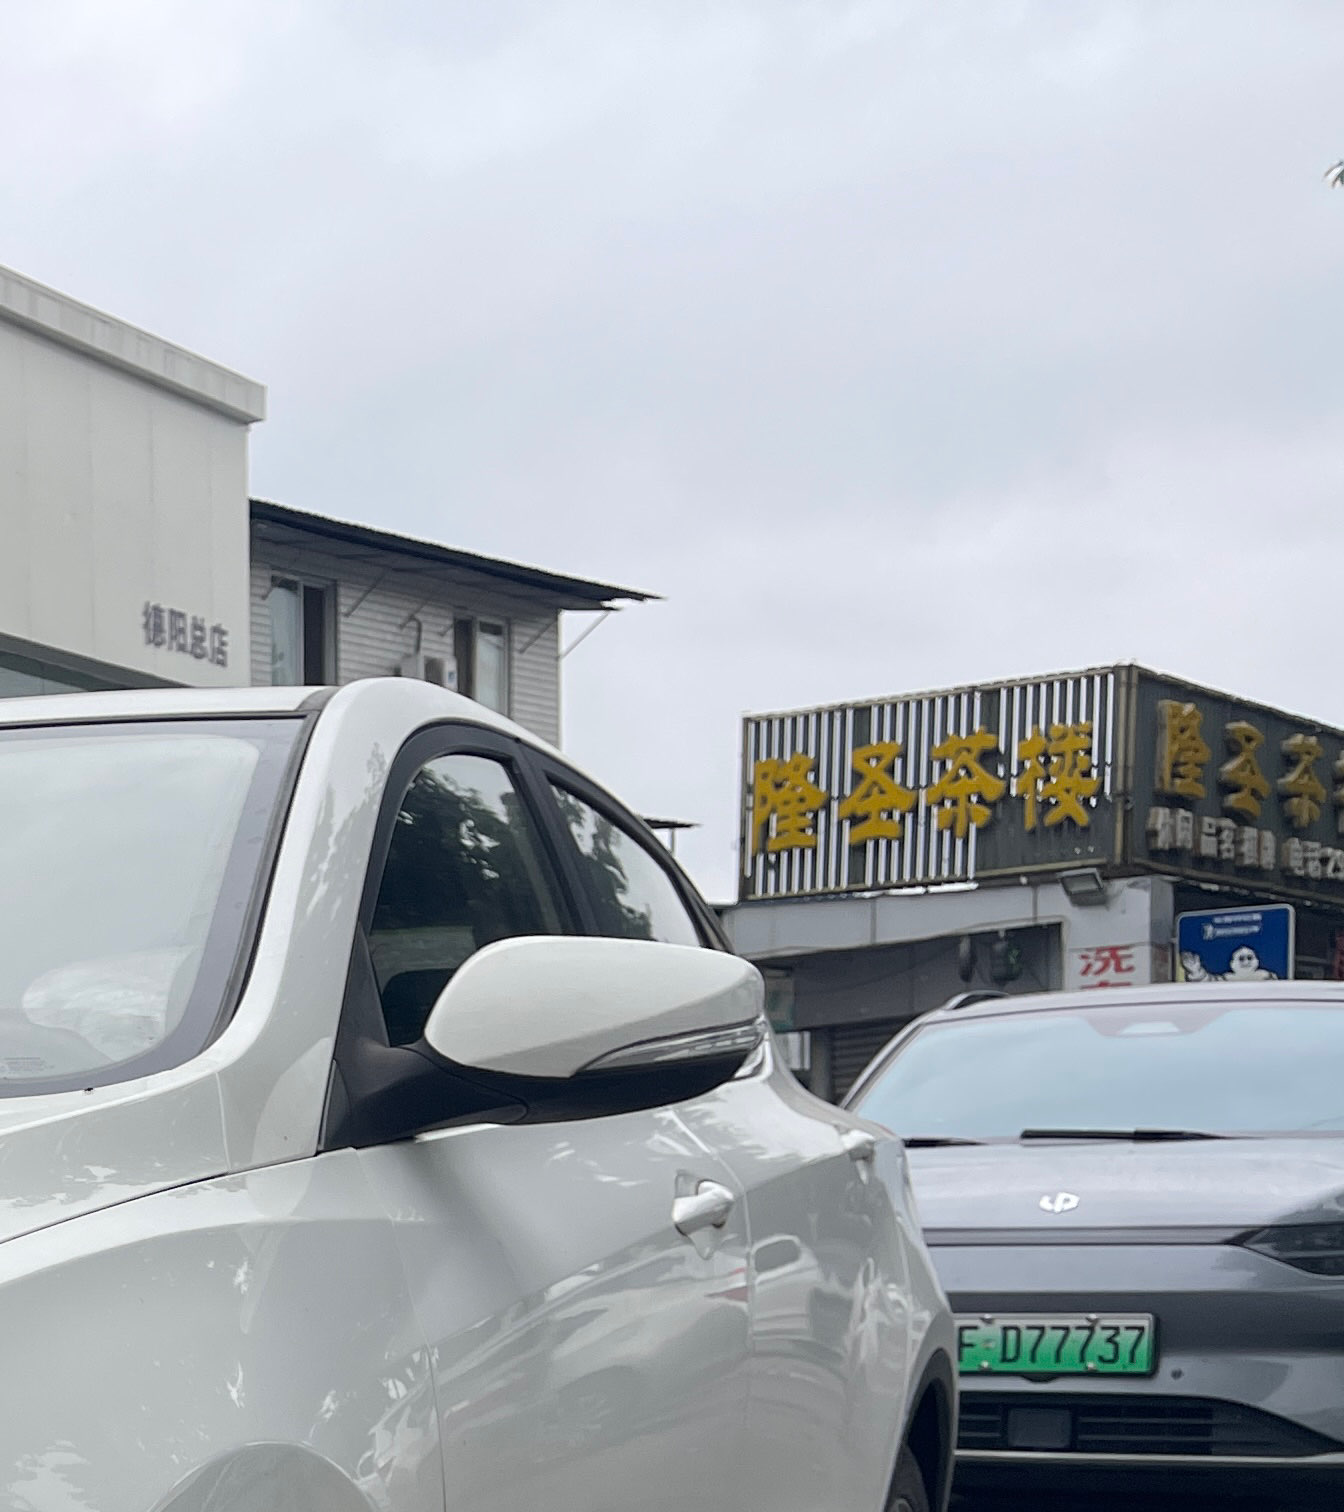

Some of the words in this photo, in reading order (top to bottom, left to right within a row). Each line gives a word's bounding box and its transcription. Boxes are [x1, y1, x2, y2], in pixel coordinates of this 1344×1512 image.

[142, 600, 229, 668] 德阳总店
[751, 721, 1102, 856] 隆圣茶楼
[1156, 699, 1344, 833] 隆圣茶
[1078, 945, 1137, 990] 洗
